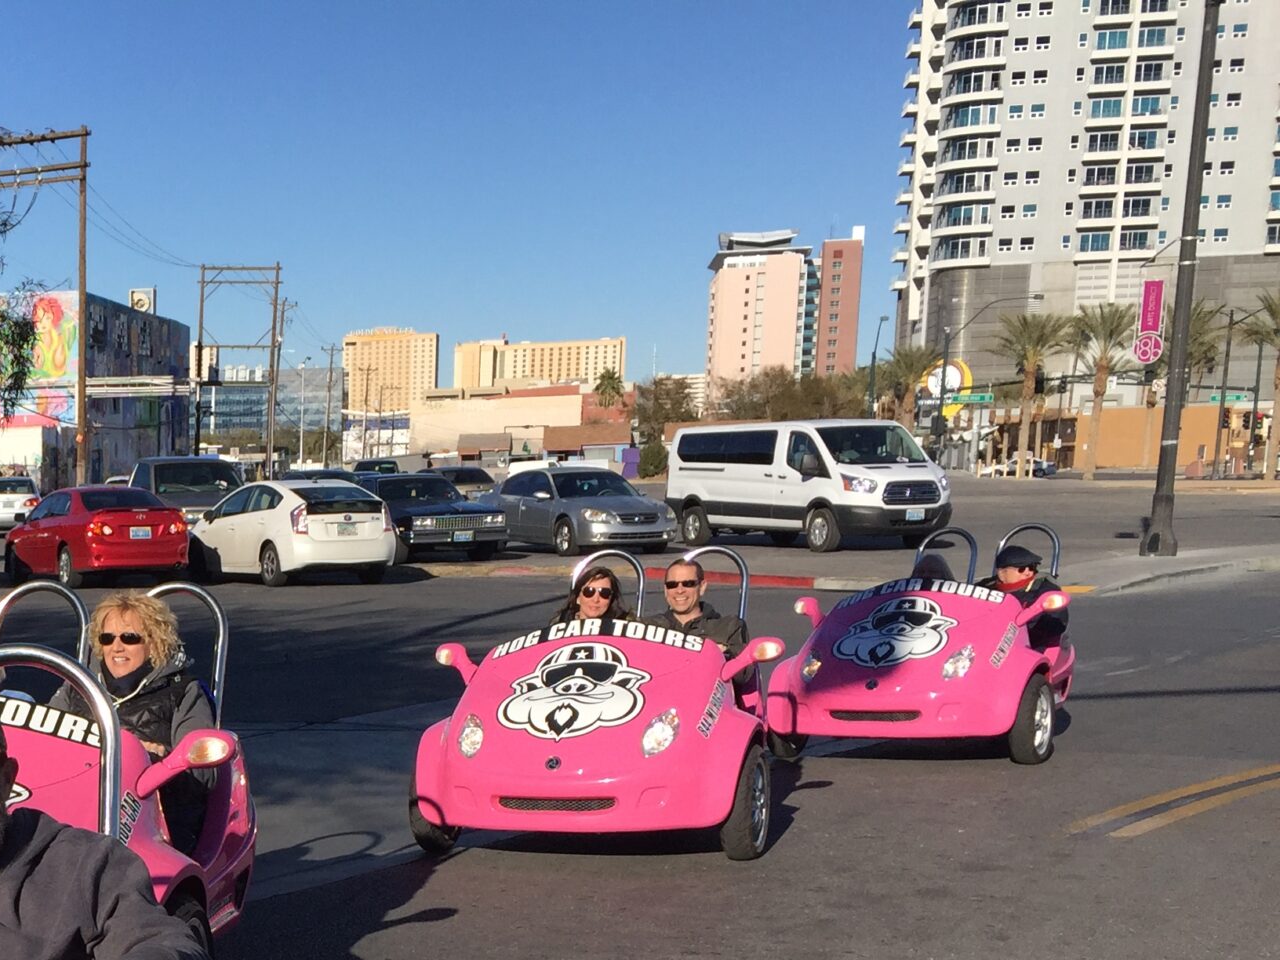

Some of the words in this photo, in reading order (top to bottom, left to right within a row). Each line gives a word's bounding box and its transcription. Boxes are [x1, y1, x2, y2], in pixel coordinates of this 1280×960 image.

[880, 578, 923, 595] CAR
[931, 578, 1004, 603] TOURS
[492, 629, 542, 660] HOG
[547, 618, 602, 641] CAR
[612, 618, 705, 651] TOURS
